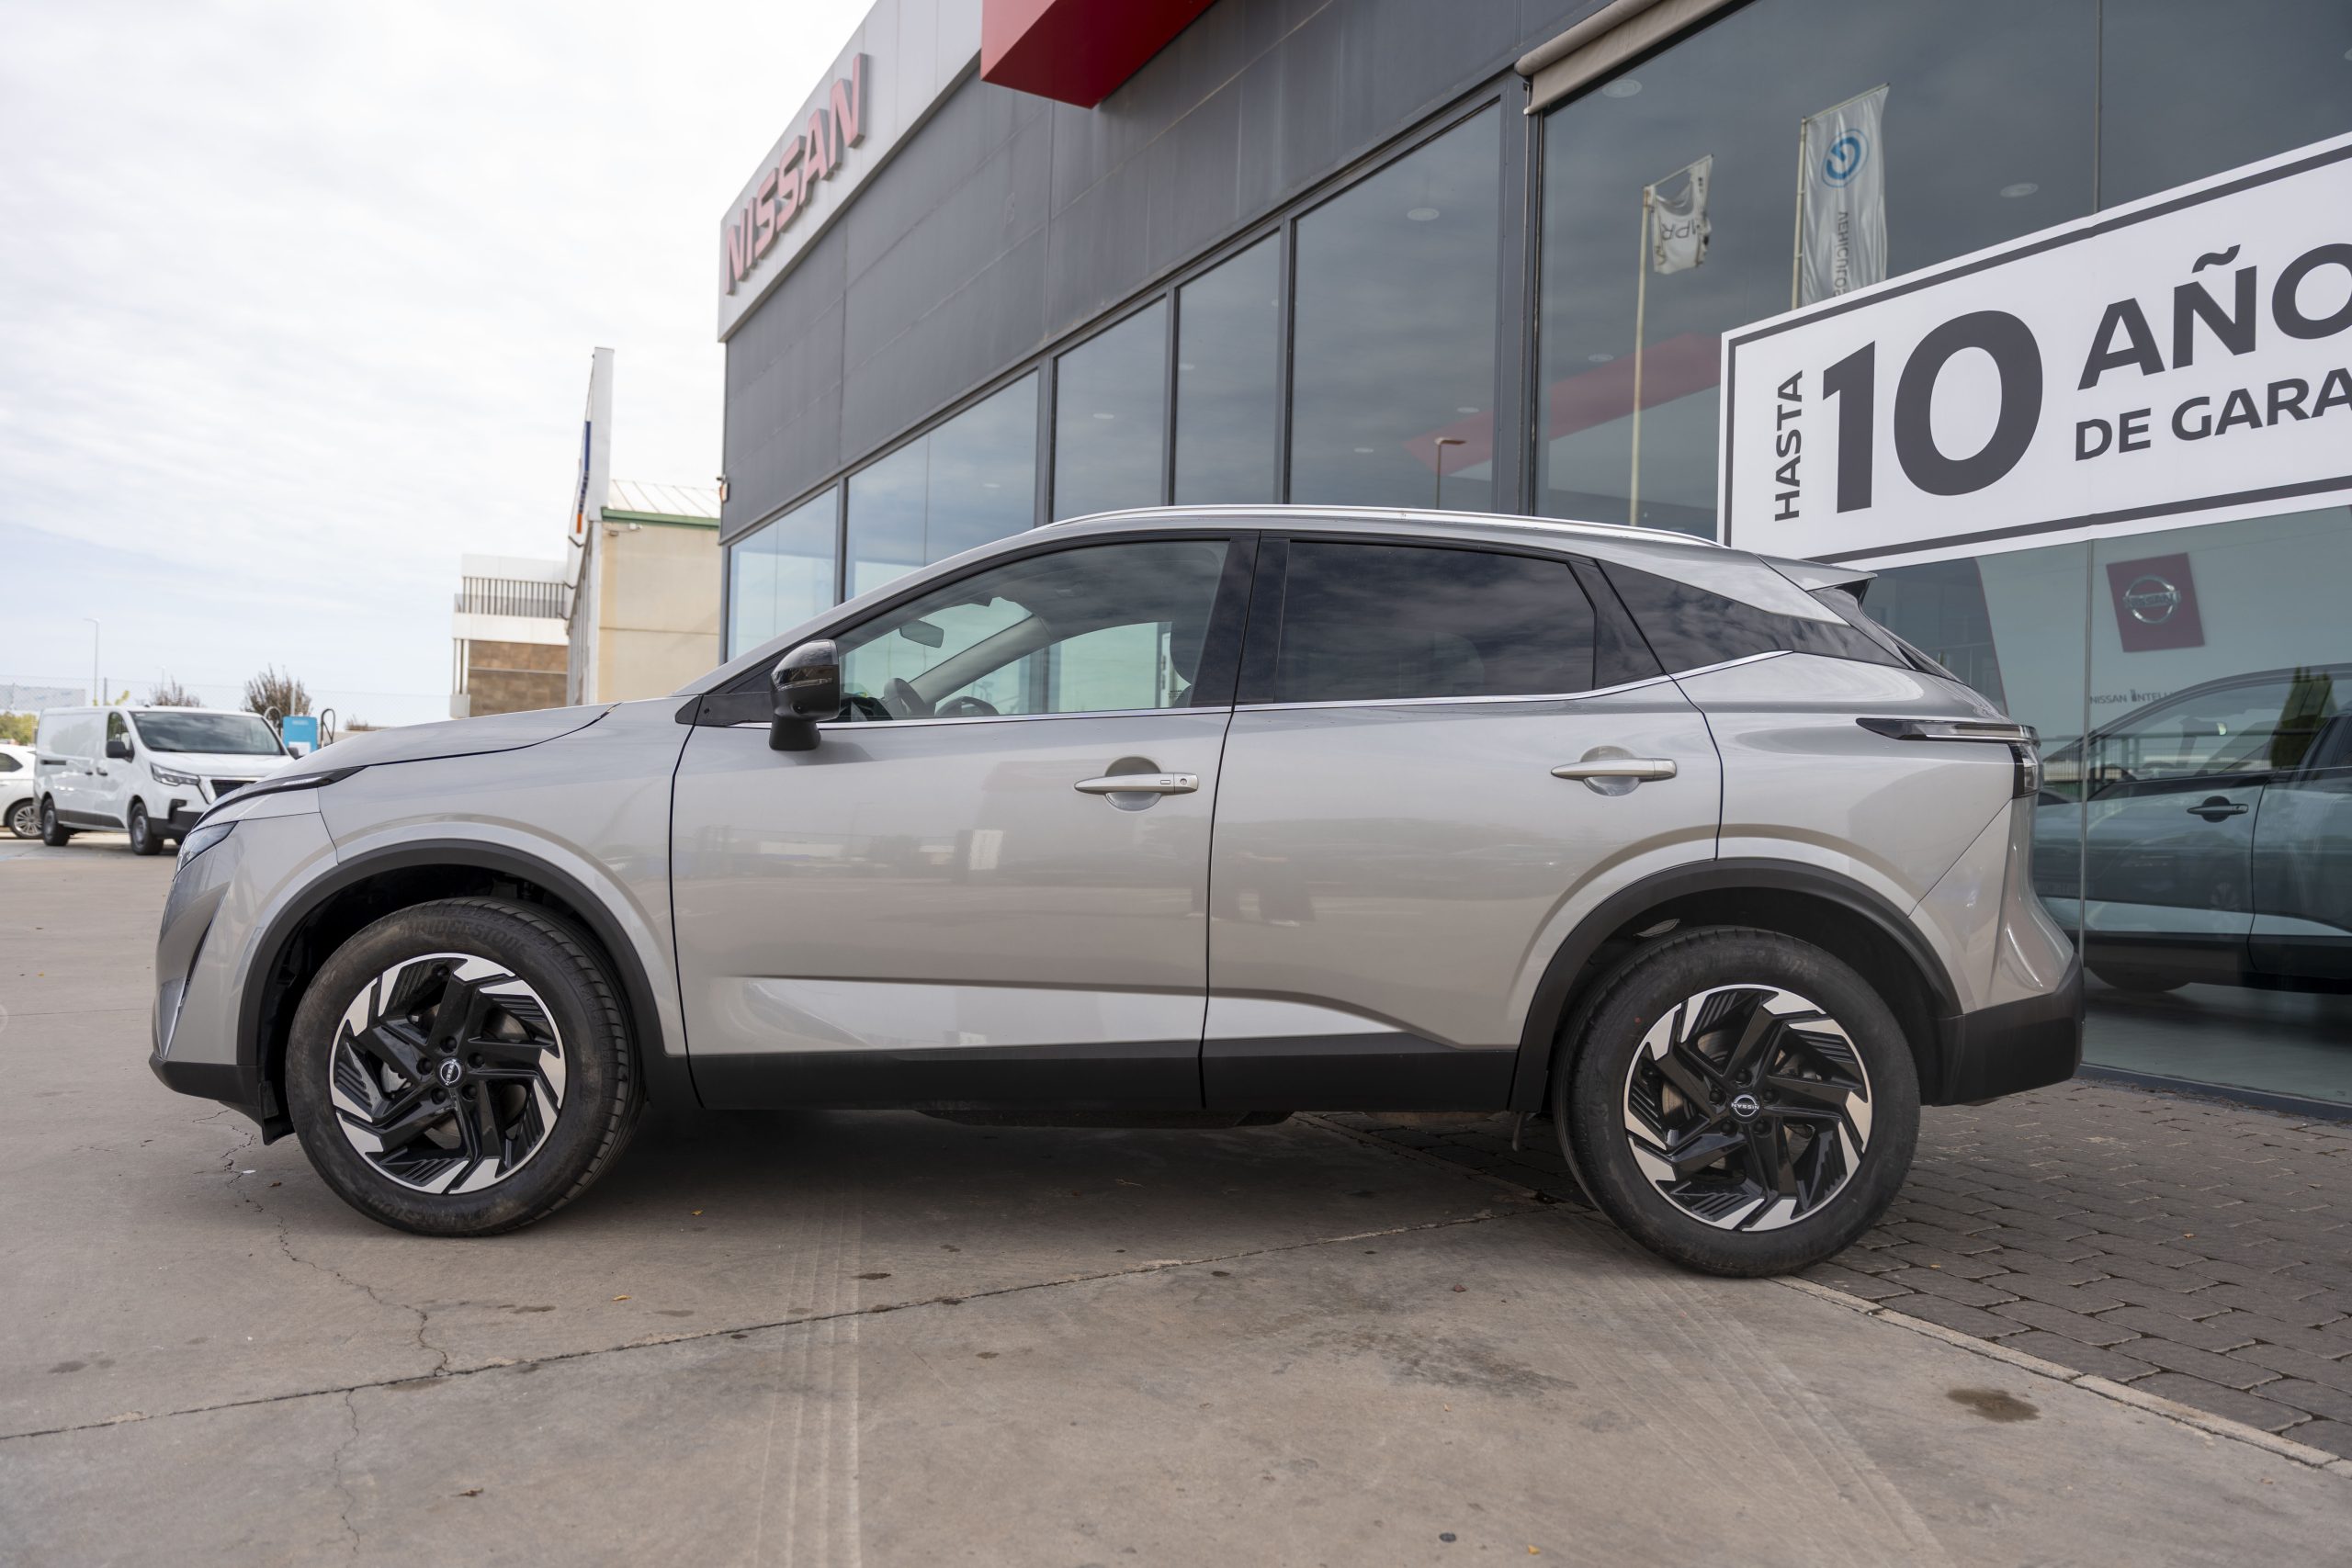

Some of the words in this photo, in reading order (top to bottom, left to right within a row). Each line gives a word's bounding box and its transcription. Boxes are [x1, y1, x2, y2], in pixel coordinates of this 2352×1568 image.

[726, 52, 868, 295] NISSAN
[2076, 243, 2352, 391] AÑO
[1774, 369, 1804, 522] HASTA
[1823, 310, 2043, 513] 10
[2075, 407, 2152, 461] DE
[2171, 367, 2352, 441] GARA
[2089, 694, 2128, 705] NISSAN
[1731, 1101, 1759, 1111] NISSAN
